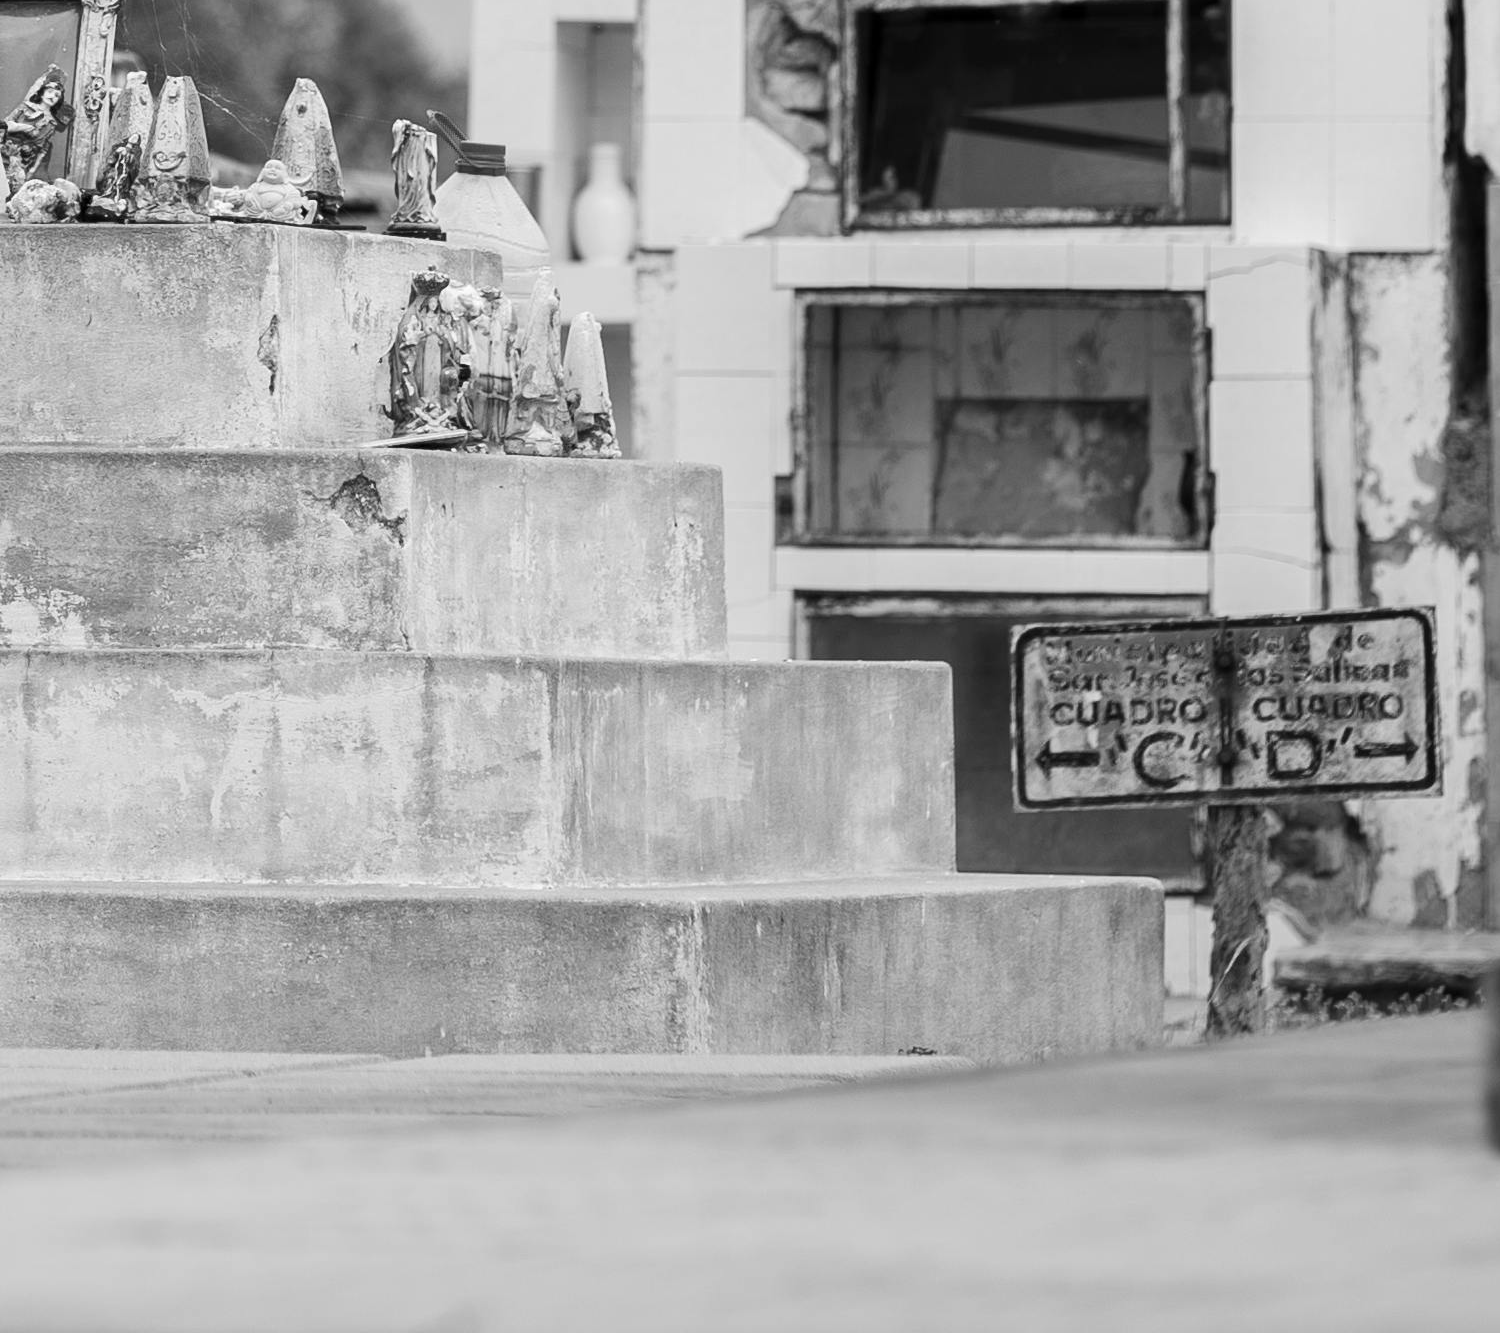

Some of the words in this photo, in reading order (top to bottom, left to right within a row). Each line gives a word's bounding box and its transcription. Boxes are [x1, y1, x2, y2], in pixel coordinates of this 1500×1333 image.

[1335, 625, 1374, 652] de
[1049, 666, 1107, 691] San
[1049, 695, 1207, 727] CUADRO
[1252, 692, 1402, 723] CUADRO
